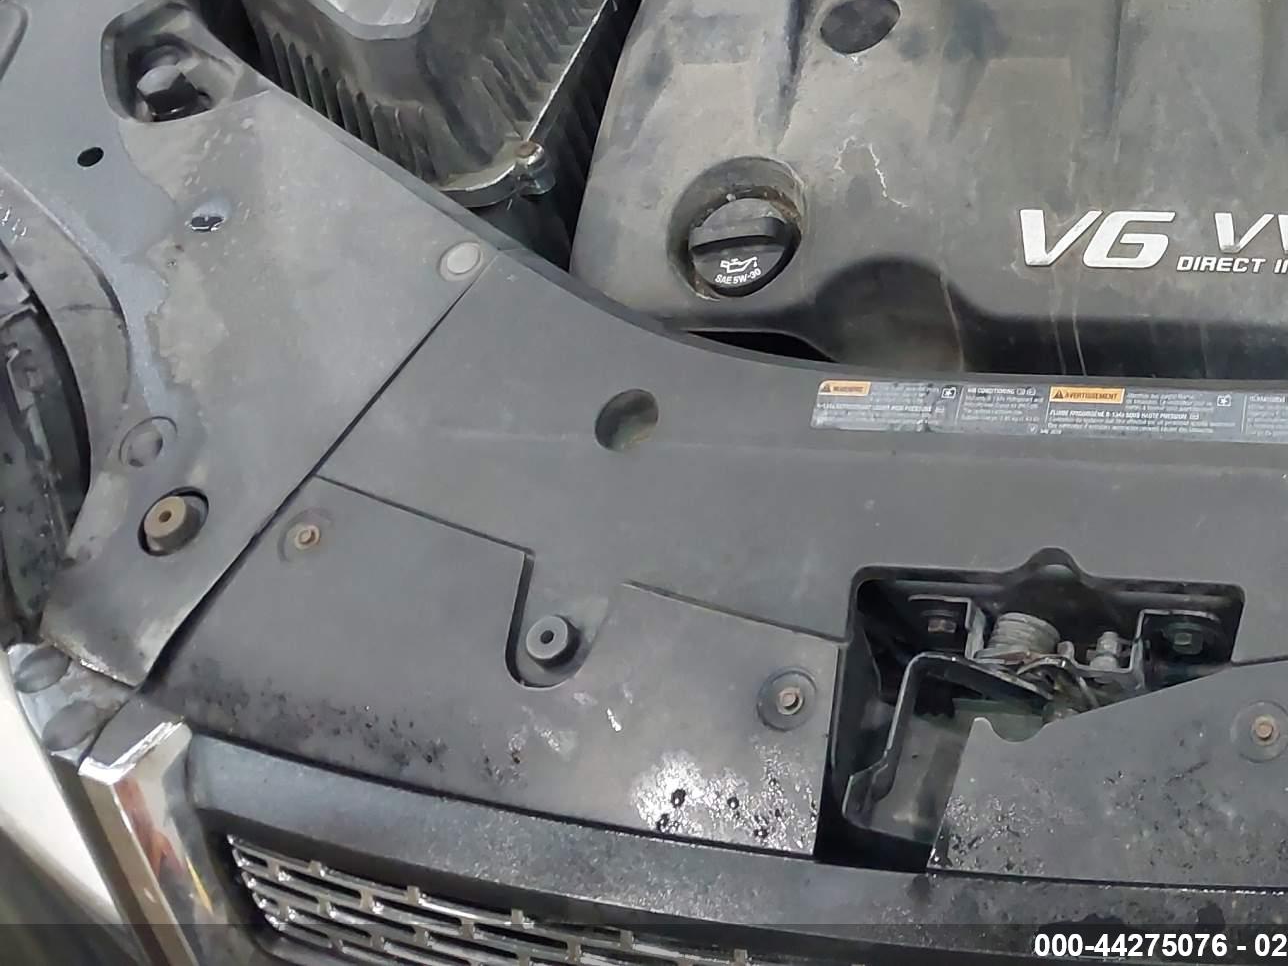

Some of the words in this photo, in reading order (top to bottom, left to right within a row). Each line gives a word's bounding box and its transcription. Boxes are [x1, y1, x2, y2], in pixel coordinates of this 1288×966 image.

[1018, 209, 1177, 269] V6
[1175, 255, 1267, 274] DIRECT
[714, 273, 732, 285] SAE
[732, 268, 762, 284] 5W-30
